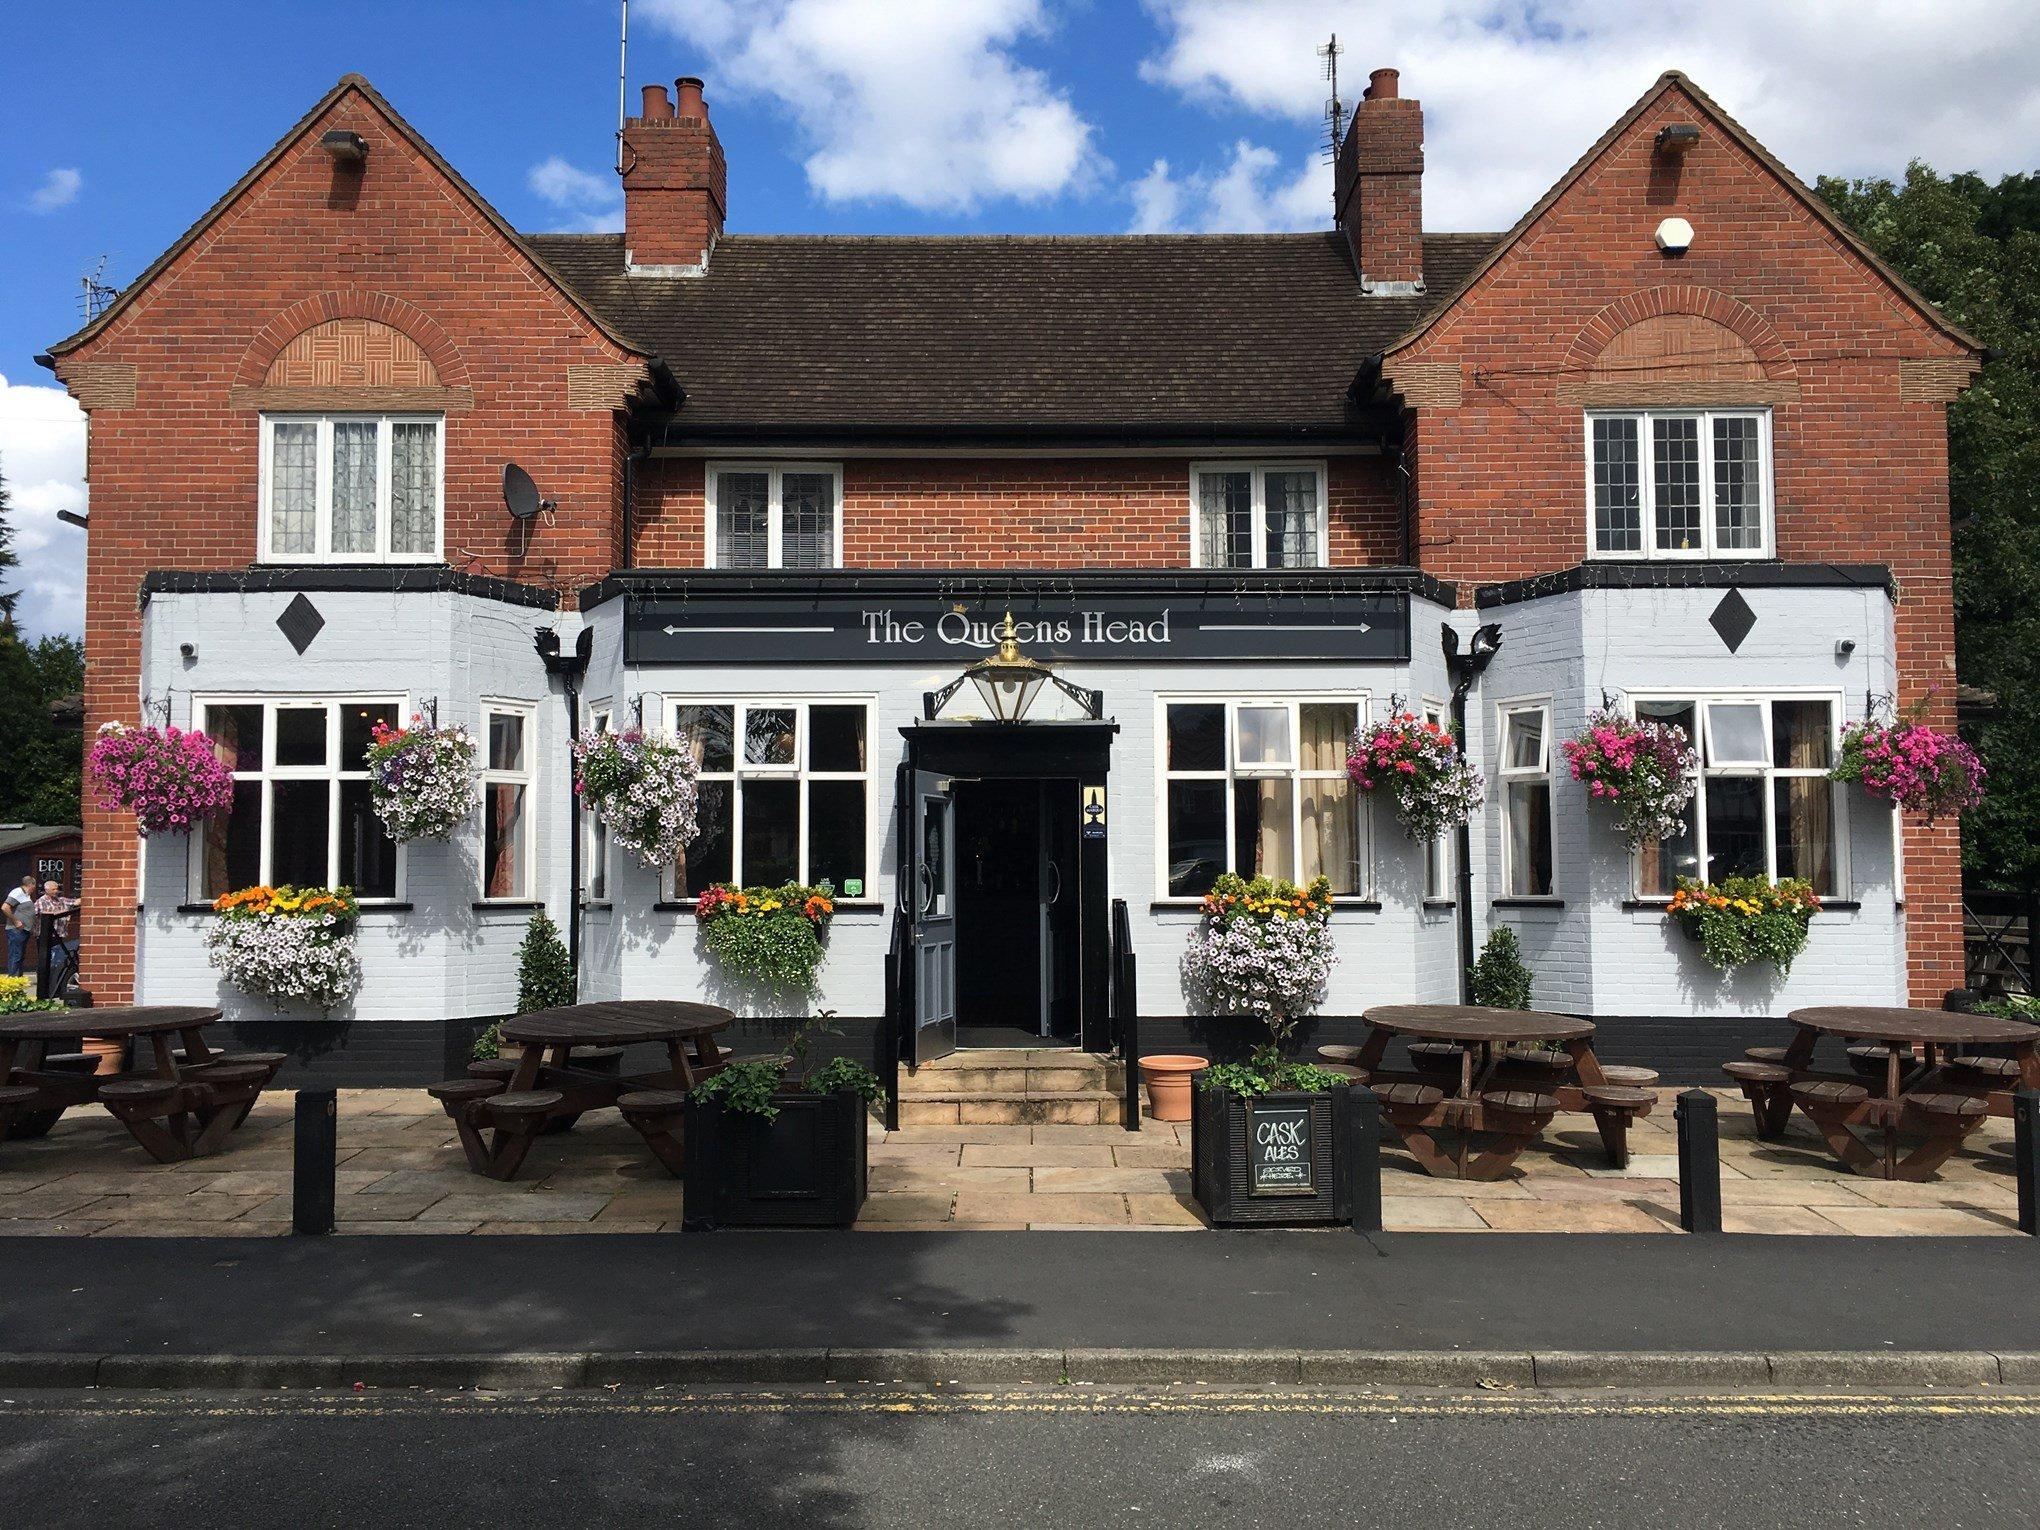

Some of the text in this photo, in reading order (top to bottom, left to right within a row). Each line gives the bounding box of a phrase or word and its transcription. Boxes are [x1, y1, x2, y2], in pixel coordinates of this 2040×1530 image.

[862, 608, 1171, 648] The Queens Head
[38, 859, 65, 872] BBQ
[1256, 1118, 1307, 1146] CASK
[1263, 1145, 1299, 1162] ALES
